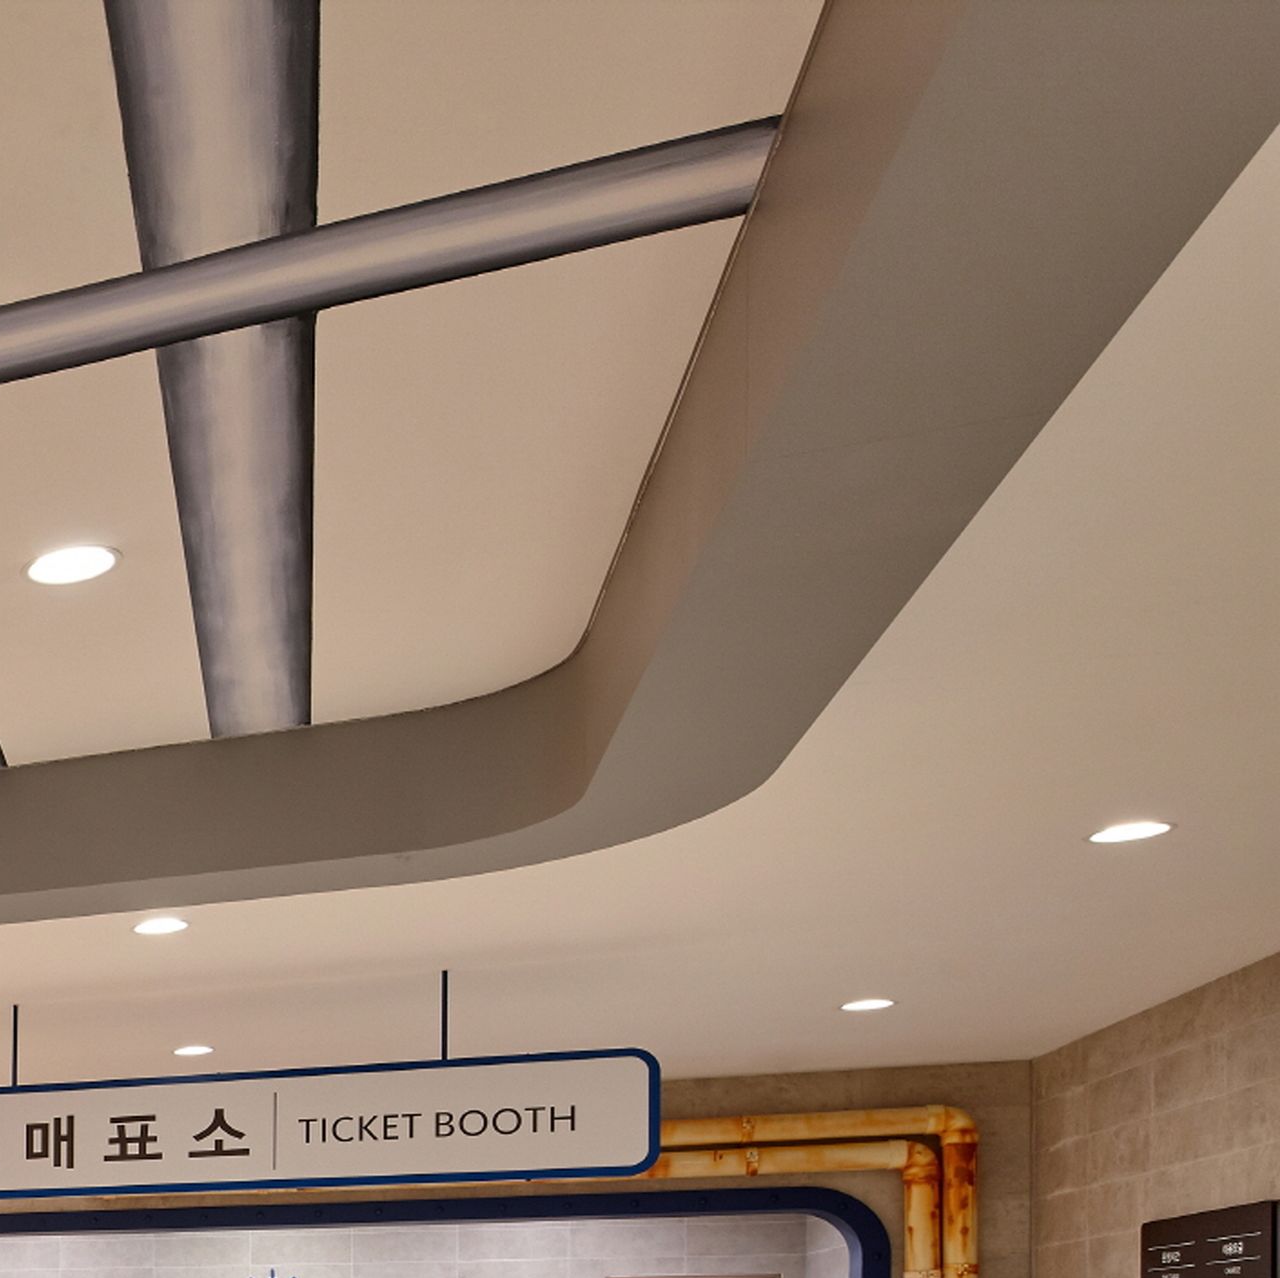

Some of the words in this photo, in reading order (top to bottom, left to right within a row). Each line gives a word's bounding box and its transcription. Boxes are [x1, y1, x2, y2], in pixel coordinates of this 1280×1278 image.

[25, 1108, 250, 1169] 매표소
[298, 1112, 422, 1144] TICKET
[434, 1105, 576, 1138] BOOTH
